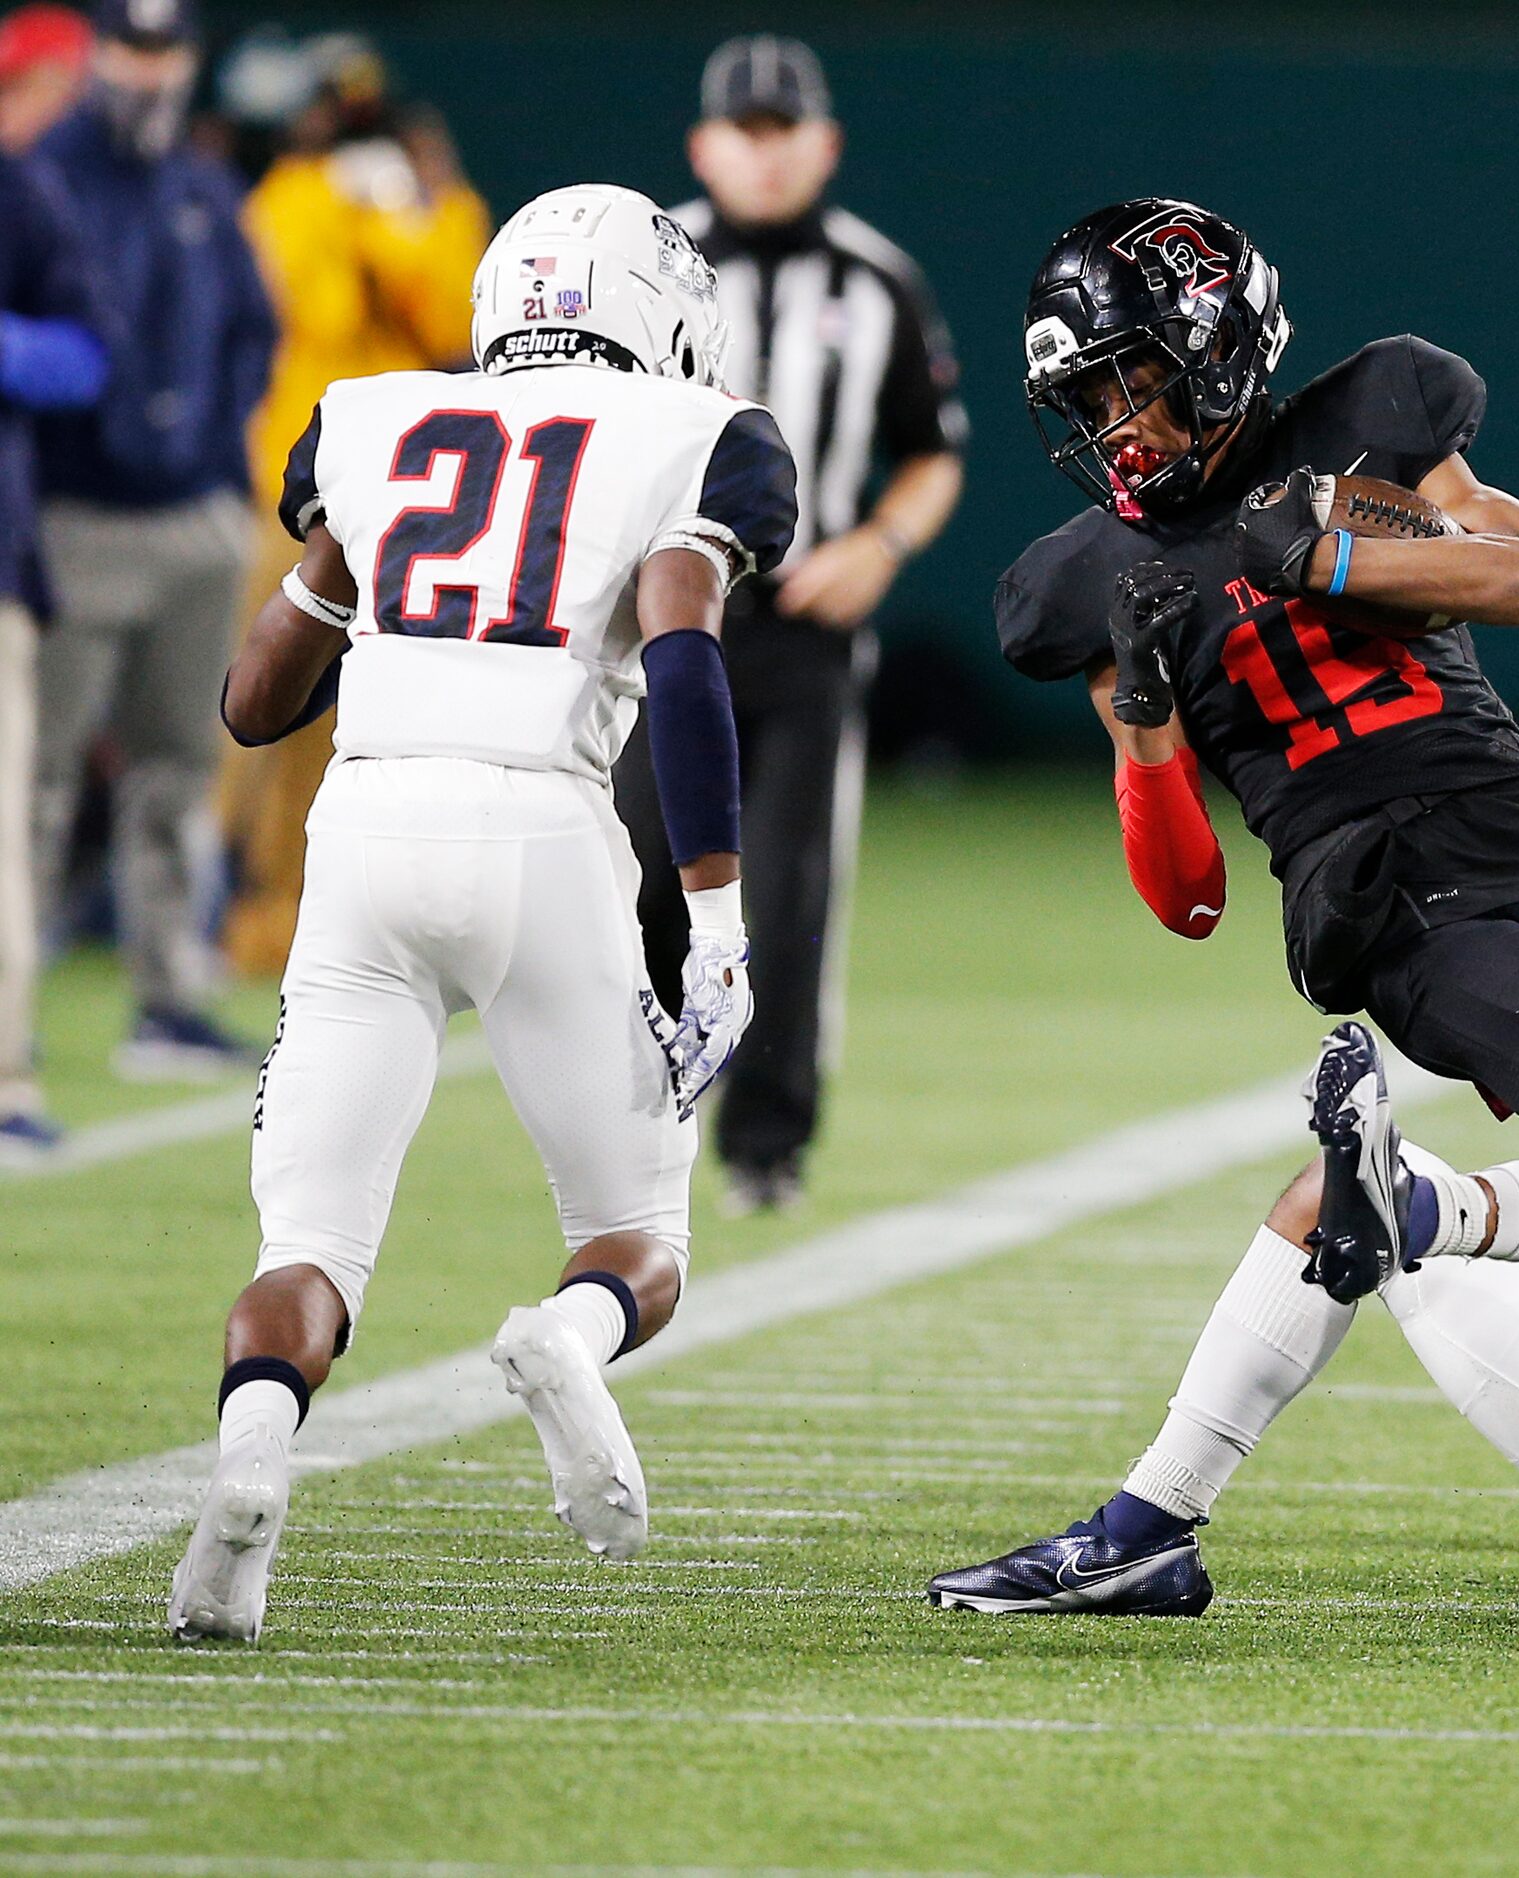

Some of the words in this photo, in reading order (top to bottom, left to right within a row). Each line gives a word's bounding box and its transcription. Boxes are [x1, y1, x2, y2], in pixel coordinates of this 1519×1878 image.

[505, 329, 580, 355] schutt
[523, 297, 547, 320] 21
[373, 408, 596, 647] 21
[1220, 597, 1444, 772] 15
